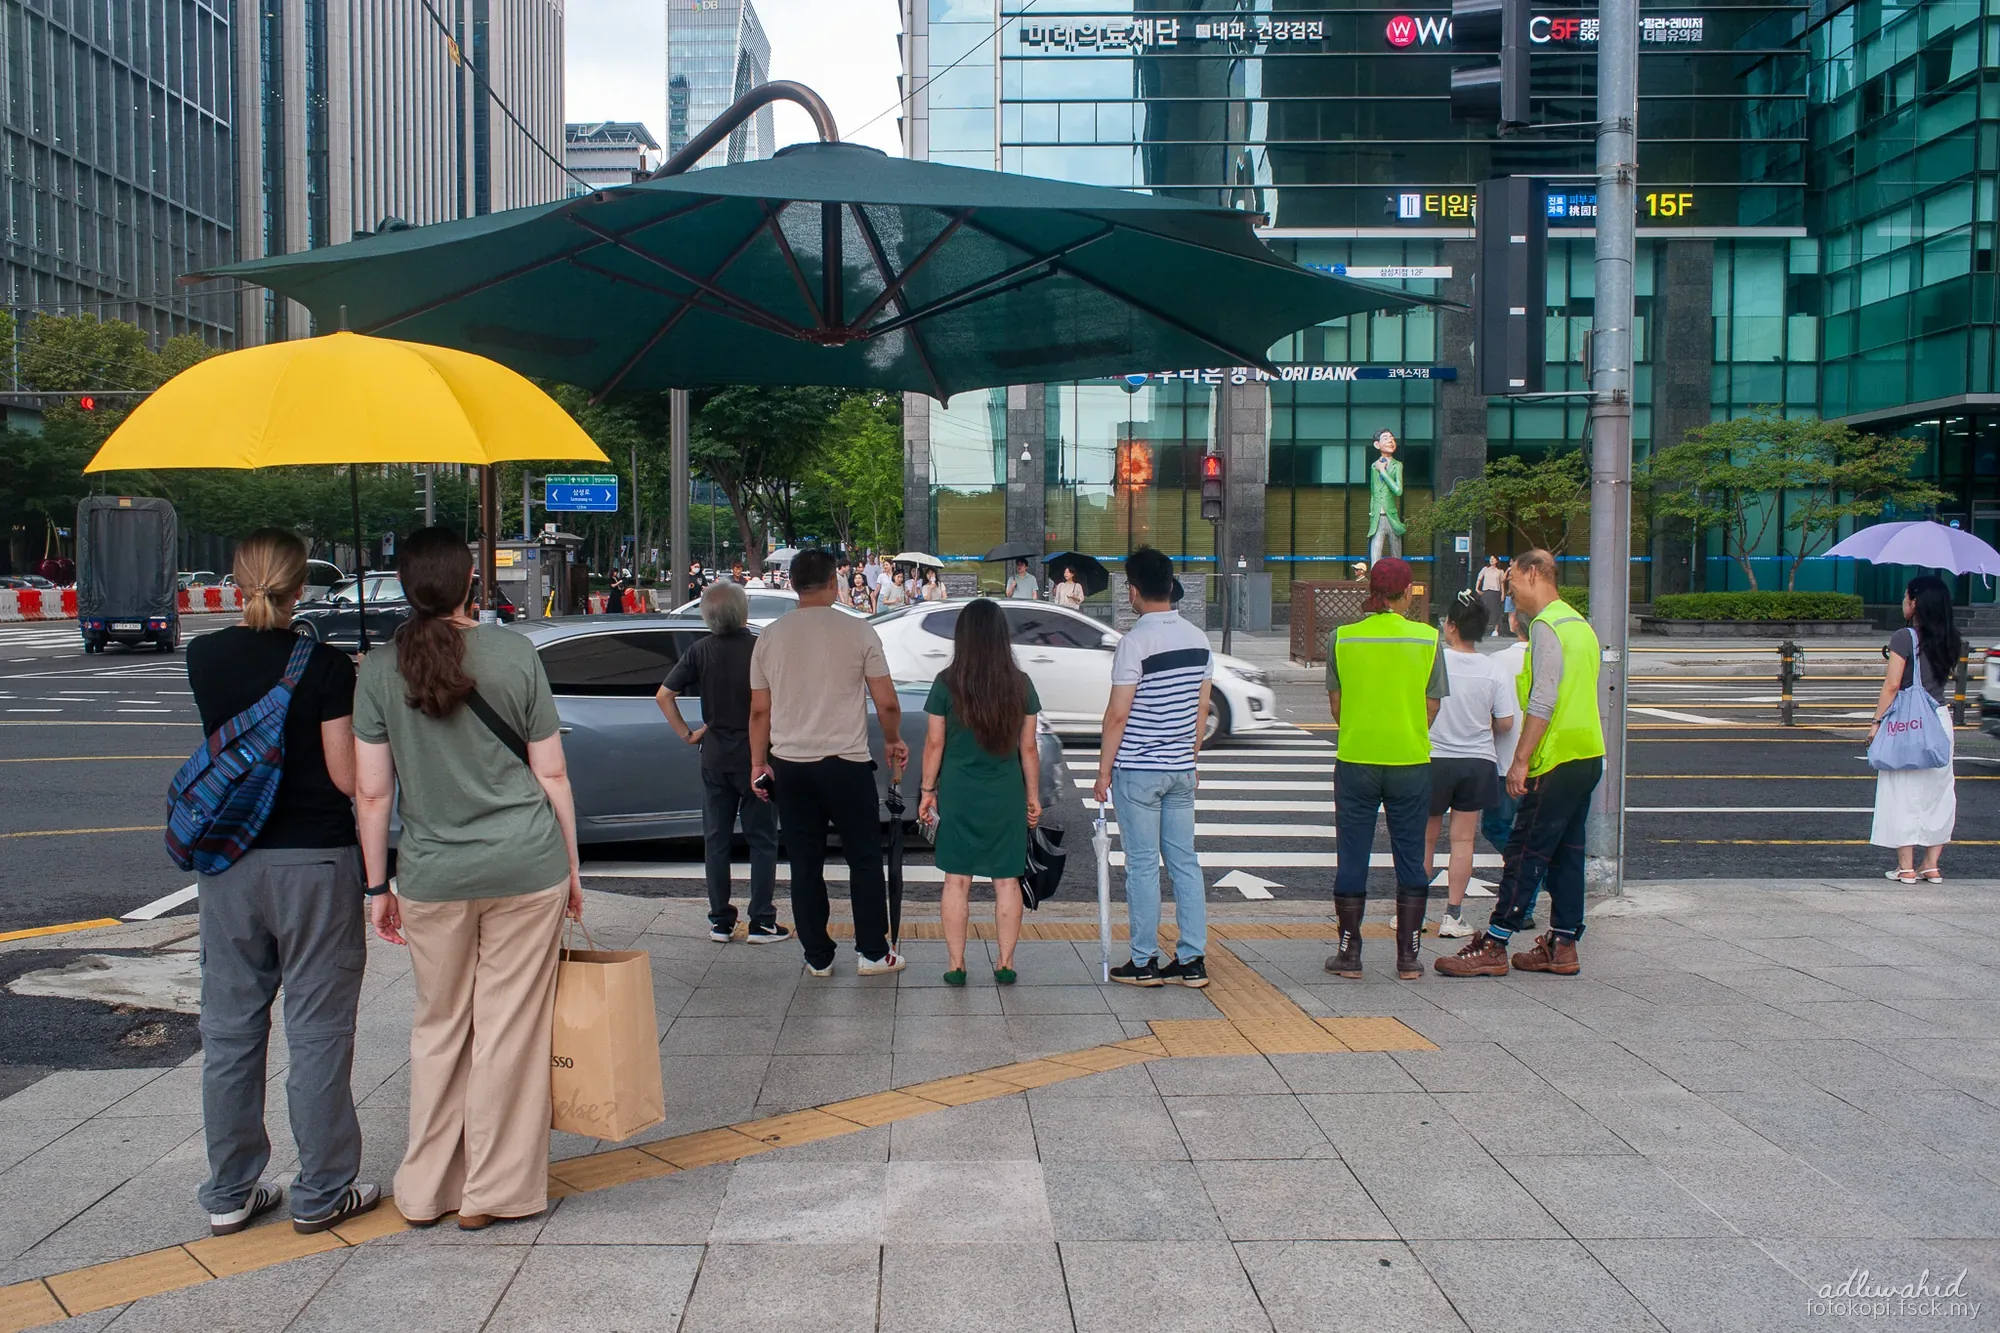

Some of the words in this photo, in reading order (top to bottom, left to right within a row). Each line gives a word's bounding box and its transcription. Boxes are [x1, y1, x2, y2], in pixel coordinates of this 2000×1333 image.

[703, 1, 718, 9] DB
[1029, 19, 1180, 46] 미래의료재단
[1257, 21, 1323, 40] 건강검진
[1415, 17, 1452, 45] W
[1643, 29, 1703, 42] 더블유의원
[1645, 193, 1694, 216] 15F
[1311, 366, 1360, 381] BANK
[1388, 368, 1430, 379] 코엑스지점
[1887, 717, 1922, 733] Merci
